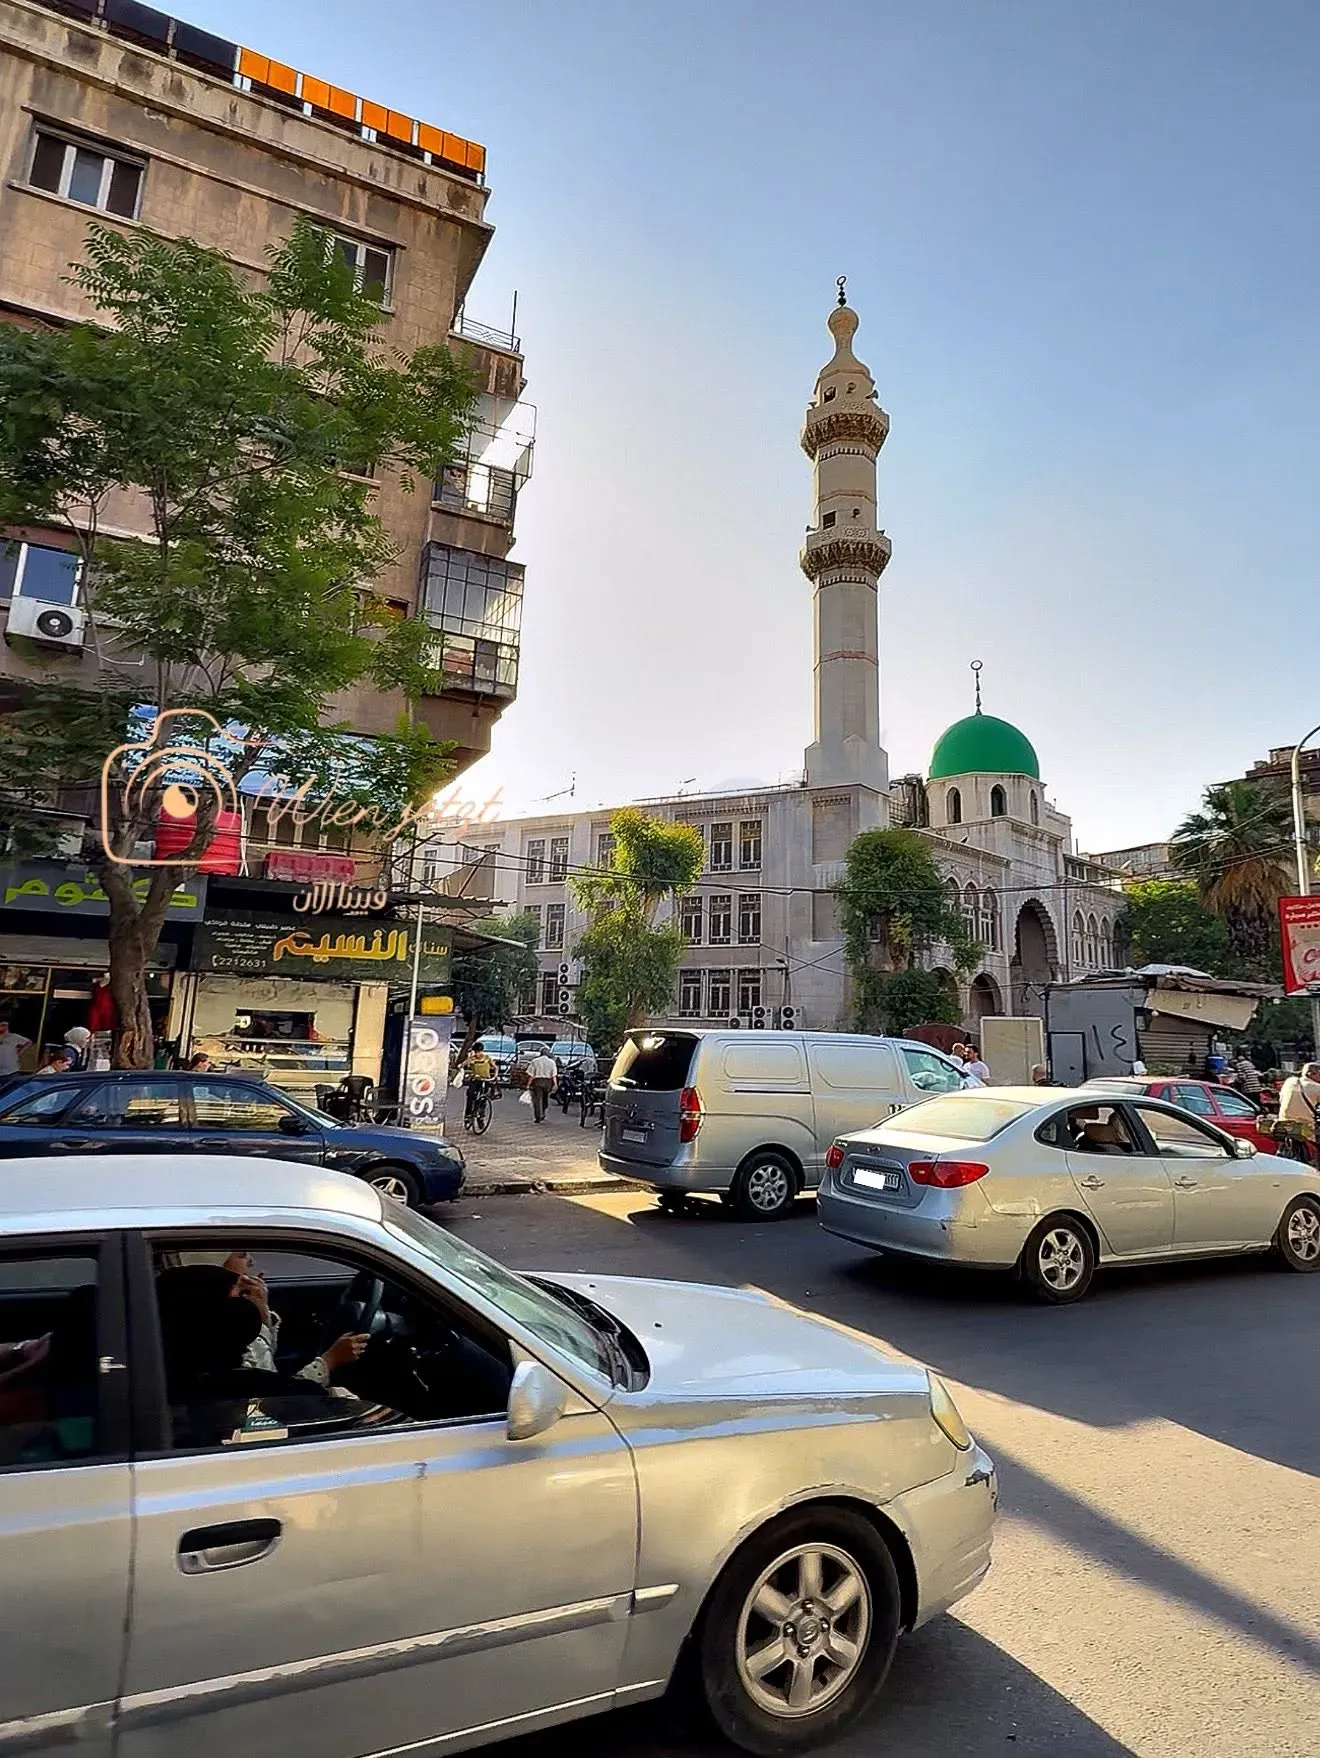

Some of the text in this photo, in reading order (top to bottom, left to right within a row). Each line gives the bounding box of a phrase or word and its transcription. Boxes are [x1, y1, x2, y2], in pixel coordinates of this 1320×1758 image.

[4, 871, 198, 907] كثوم
[218, 957, 267, 968] 2212631
[272, 928, 408, 964] النسيم
[409, 1027, 439, 1122] ppsi
